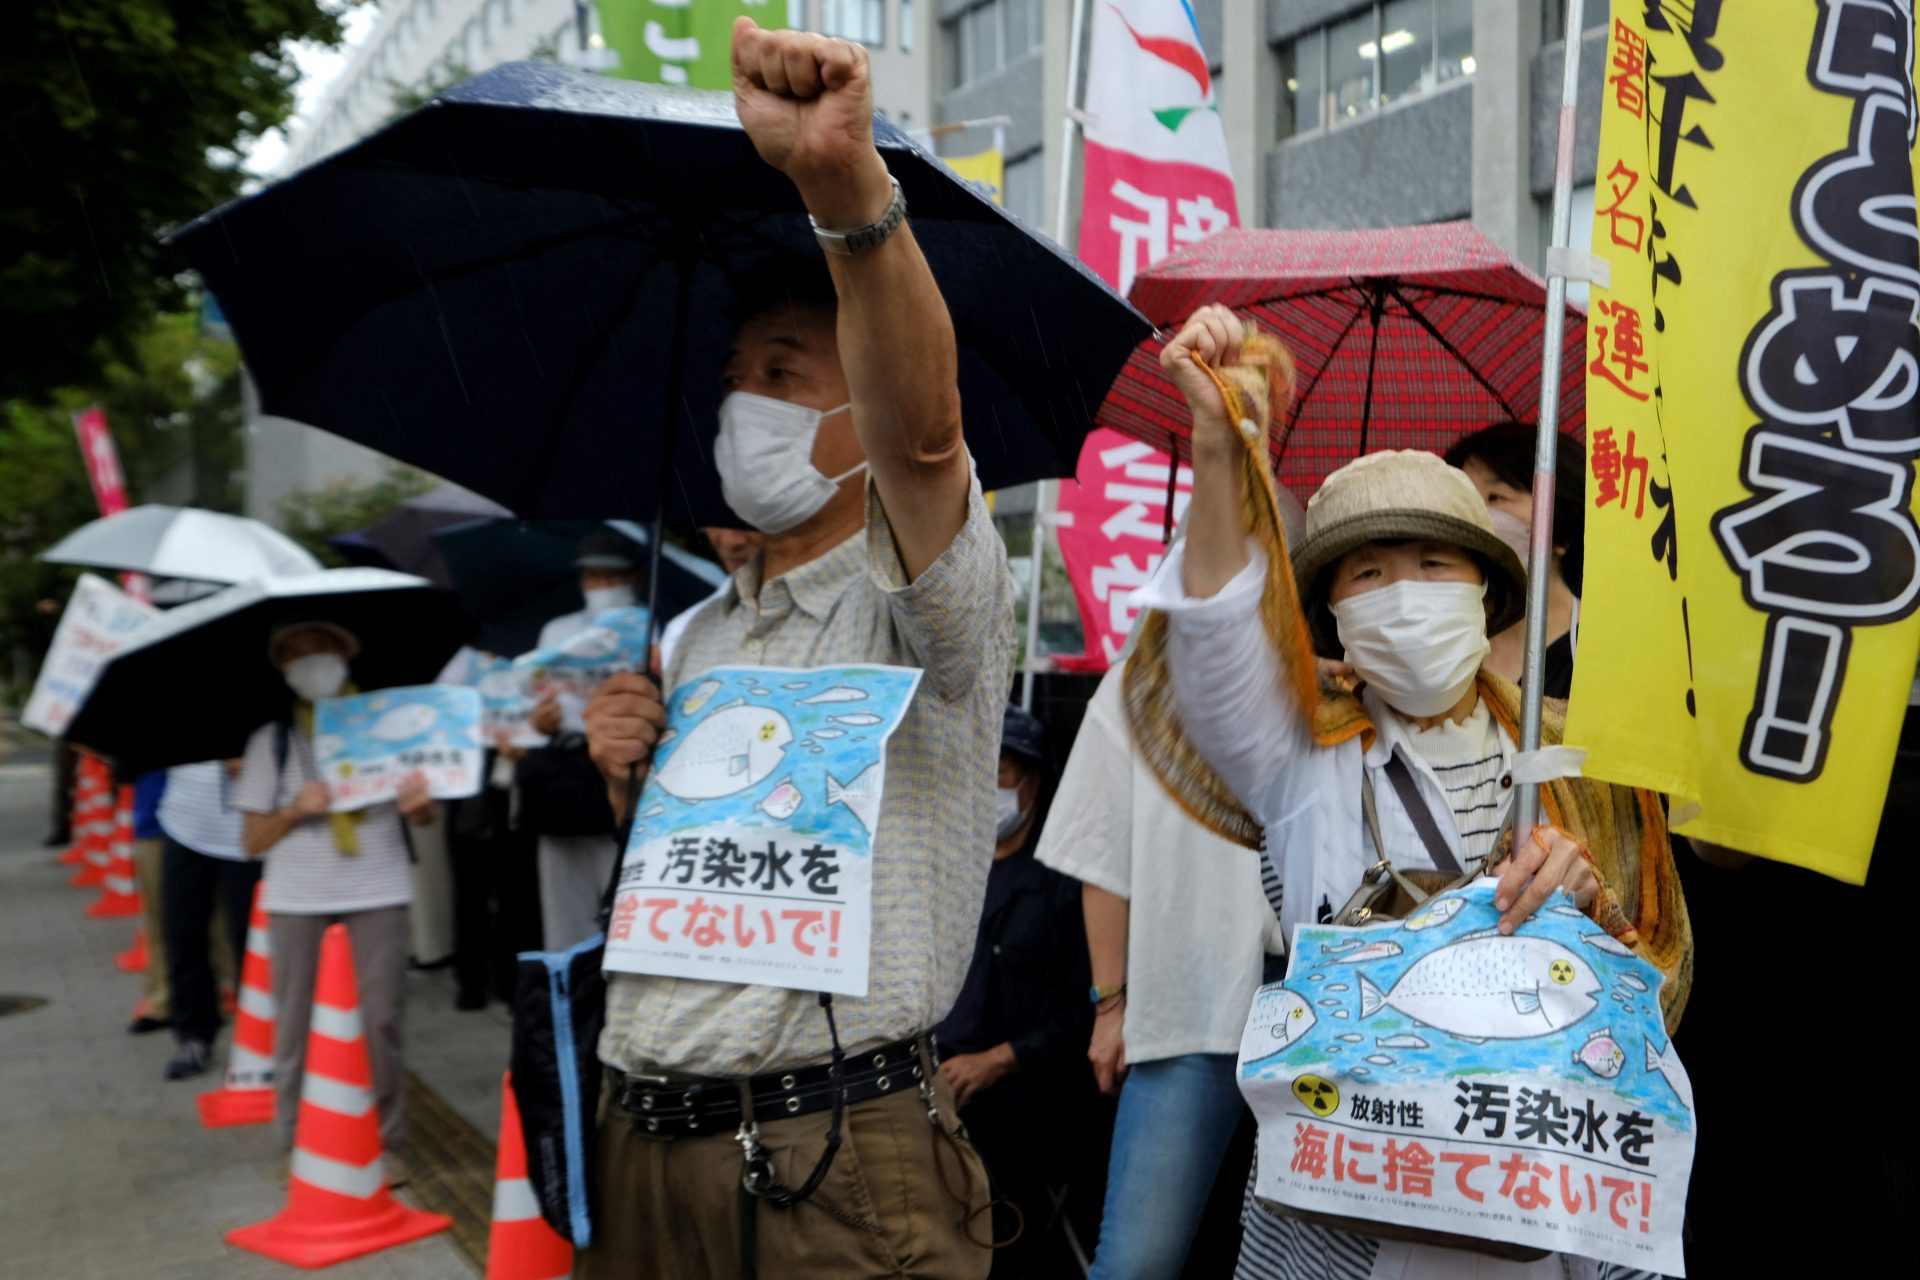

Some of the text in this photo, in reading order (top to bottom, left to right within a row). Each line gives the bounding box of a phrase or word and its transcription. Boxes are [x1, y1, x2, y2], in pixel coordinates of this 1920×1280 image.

[1586, 17, 1649, 519] 署名運動
[1714, 0, 1920, 783] とめる!
[660, 837, 841, 895] 汚染水を
[1290, 1122, 1652, 1233] 海に捨てないで!
[1350, 1079, 1654, 1167] 放射性 汚染水を
